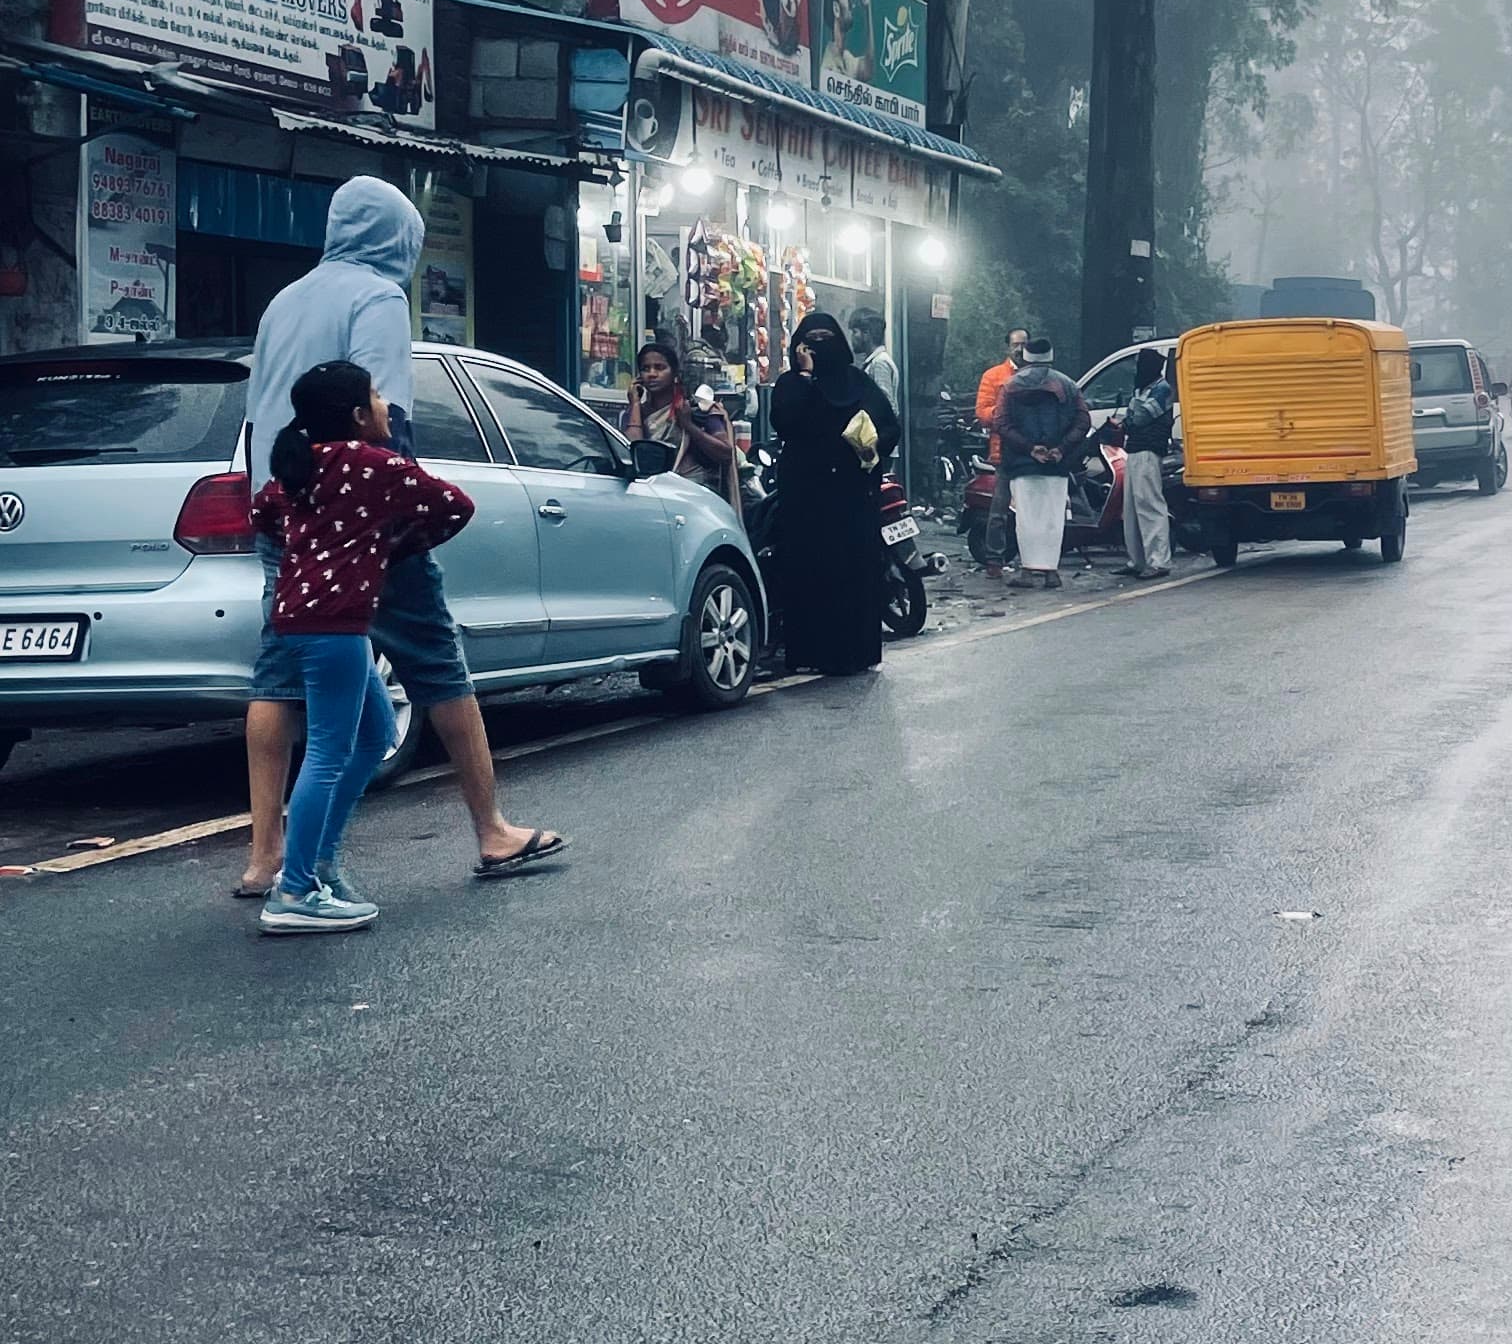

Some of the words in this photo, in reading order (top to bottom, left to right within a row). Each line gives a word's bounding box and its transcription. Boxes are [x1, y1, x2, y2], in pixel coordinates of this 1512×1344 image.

[884, 22, 915, 71] Sprite
[827, 77, 873, 107] செந்தில்
[874, 96, 899, 116] காபி
[901, 104, 919, 123] பார்
[104, 146, 161, 175] Nagaraj
[92, 173, 132, 194] 94893
[135, 179, 170, 200] 76761
[92, 201, 132, 221] 88383
[134, 207, 170, 226] 40191
[3, 628, 17, 651] E
[21, 627, 74, 650] 6464
